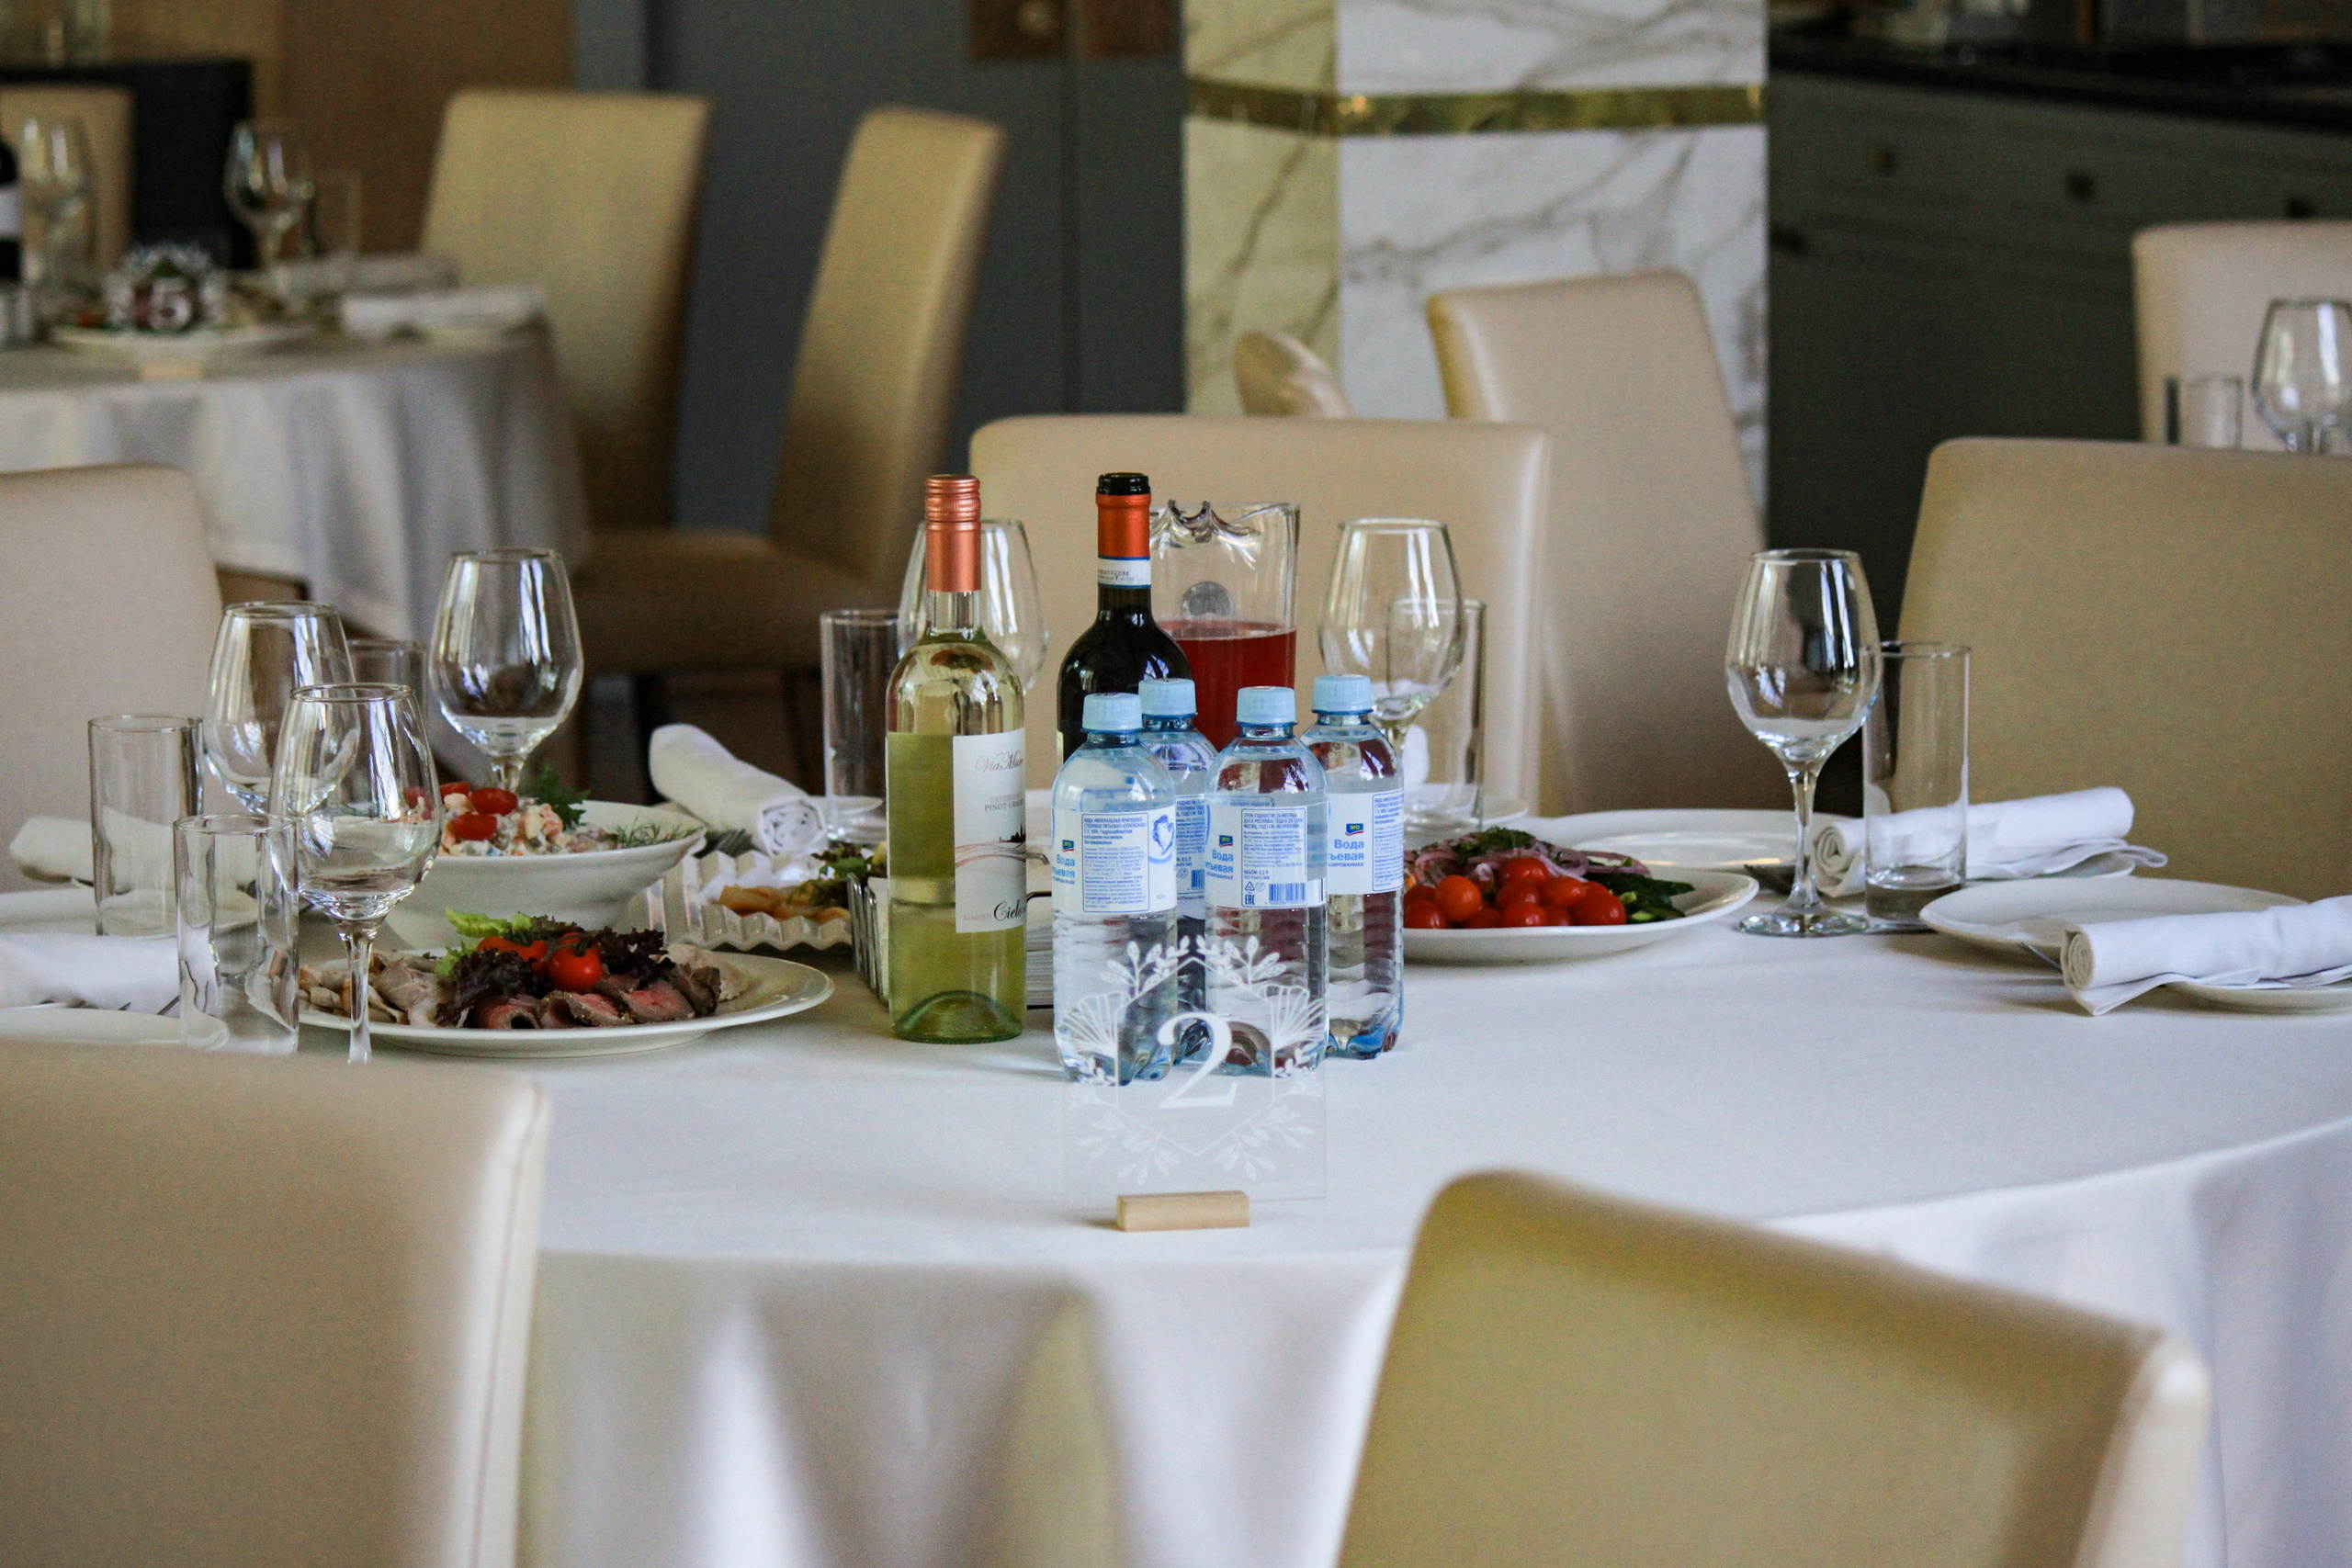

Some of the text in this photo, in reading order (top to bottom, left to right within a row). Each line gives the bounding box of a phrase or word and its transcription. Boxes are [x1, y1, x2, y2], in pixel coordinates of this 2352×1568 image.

[147, 277, 191, 331] 5
[984, 803, 1007, 812] PINOT
[1334, 839, 1364, 850] Вода
[1057, 853, 1076, 867] Вода
[1212, 849, 1234, 862] Вода
[993, 899, 1022, 922] Cielo
[1158, 1011, 1238, 1109] 2
